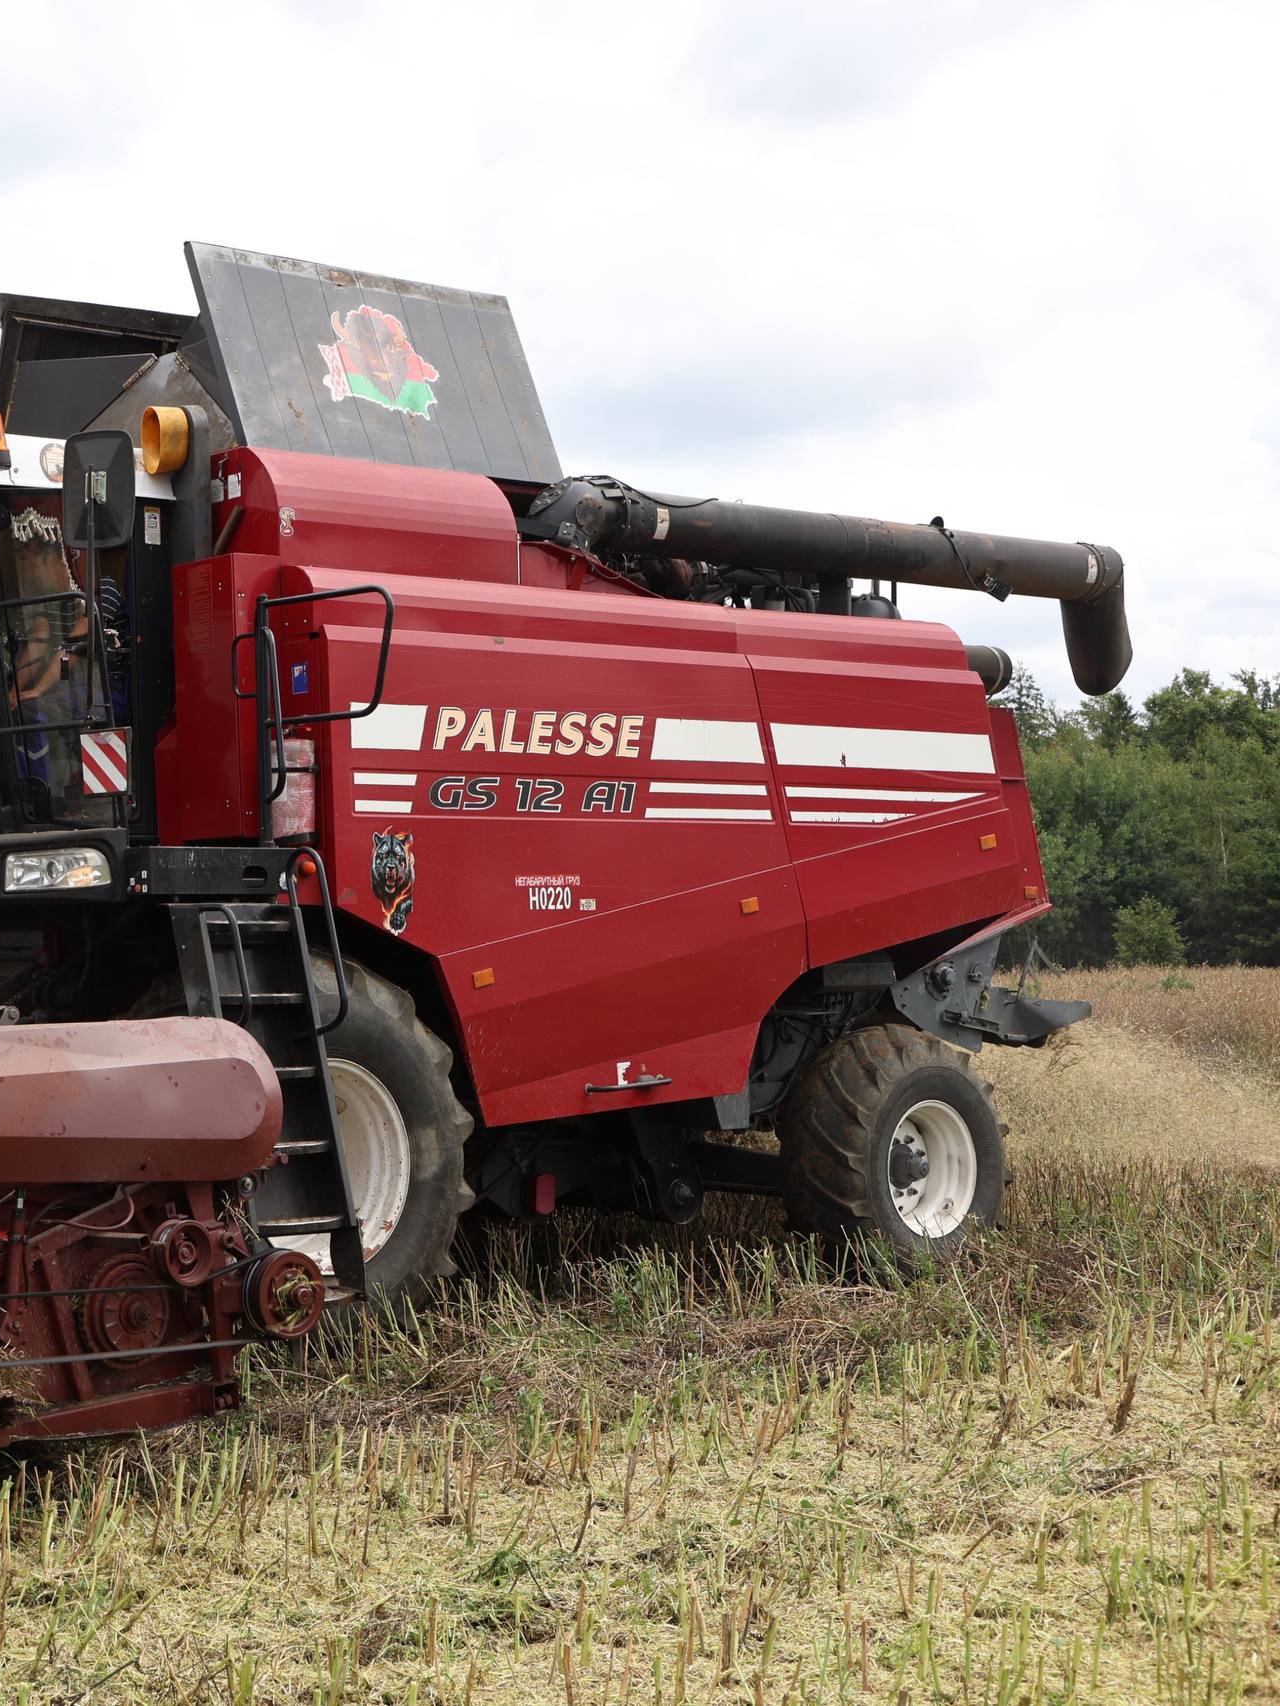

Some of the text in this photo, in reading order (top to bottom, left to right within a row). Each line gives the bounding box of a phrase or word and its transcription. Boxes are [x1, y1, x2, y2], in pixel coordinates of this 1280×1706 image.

[432, 706, 645, 759] PALESSE
[429, 776, 637, 814] GS 12 A1
[565, 876, 581, 886] ГРУЗ
